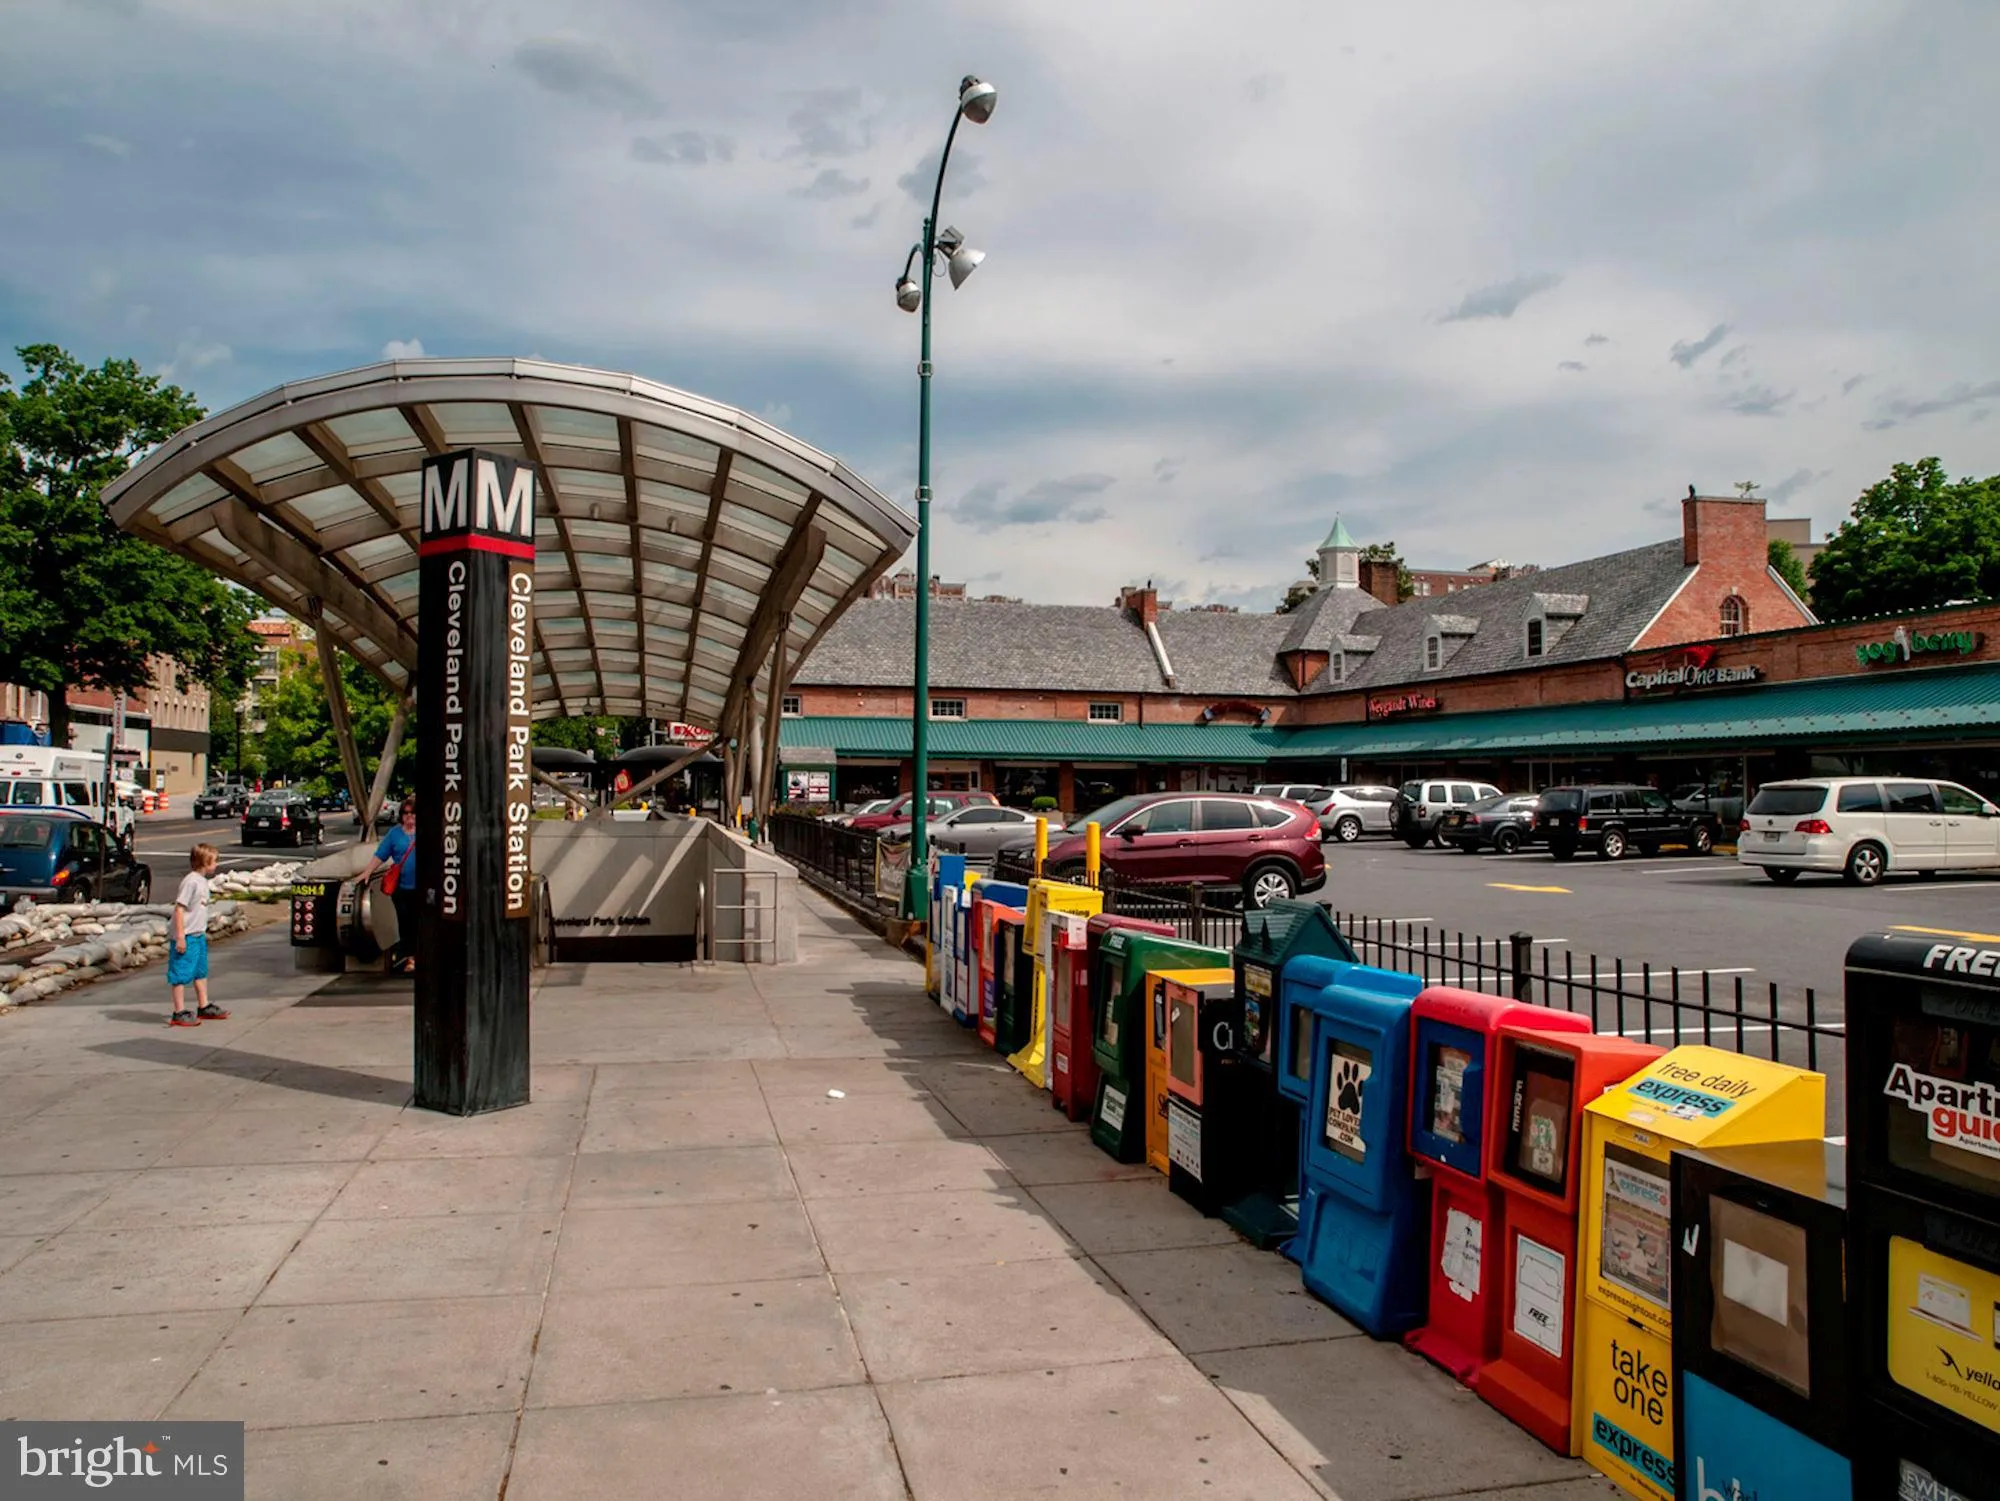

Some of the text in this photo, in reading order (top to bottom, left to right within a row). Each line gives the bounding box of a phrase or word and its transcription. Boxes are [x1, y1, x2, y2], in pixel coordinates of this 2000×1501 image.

[424, 458, 468, 534] M
[476, 458, 534, 538] M
[1716, 664, 1757, 683] Bank
[443, 560, 466, 915] Cleveland Park Station
[507, 572, 532, 911] Cleveland Park Station
[1923, 943, 2000, 978] FRE
[1636, 1079, 1727, 1113] express
[1656, 1061, 1757, 1100] free daily
[1888, 1065, 2000, 1119] Apart
[1932, 1106, 2000, 1141] gui
[1528, 1307, 1550, 1328] FREE
[1610, 1339, 1669, 1398] take
[1613, 1376, 1664, 1426] one
